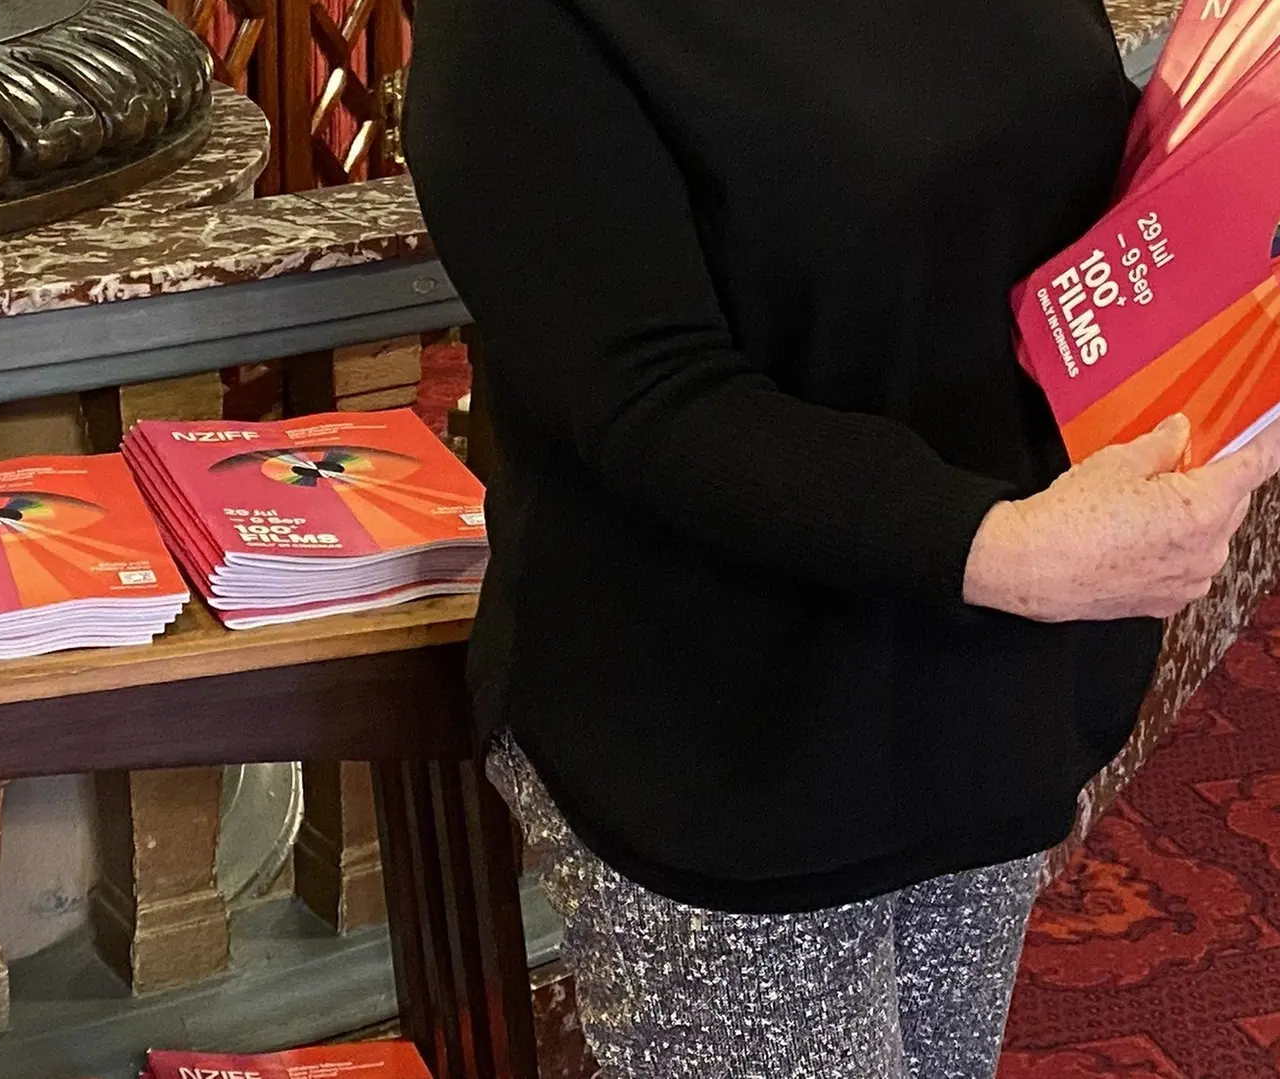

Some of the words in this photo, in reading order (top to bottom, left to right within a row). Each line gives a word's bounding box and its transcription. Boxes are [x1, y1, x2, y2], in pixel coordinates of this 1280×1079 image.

[1137, 212, 1162, 241] 29
[1121, 247, 1141, 266] 9
[1148, 238, 1175, 268] Jul
[1128, 263, 1153, 305] Sep
[1037, 287, 1055, 316] ONLY
[1051, 266, 1108, 365] FILMS
[1048, 313, 1060, 330] IN
[1053, 327, 1079, 378] CINEMAS
[170, 430, 260, 442] NZIFF
[239, 533, 340, 544] FILMS
